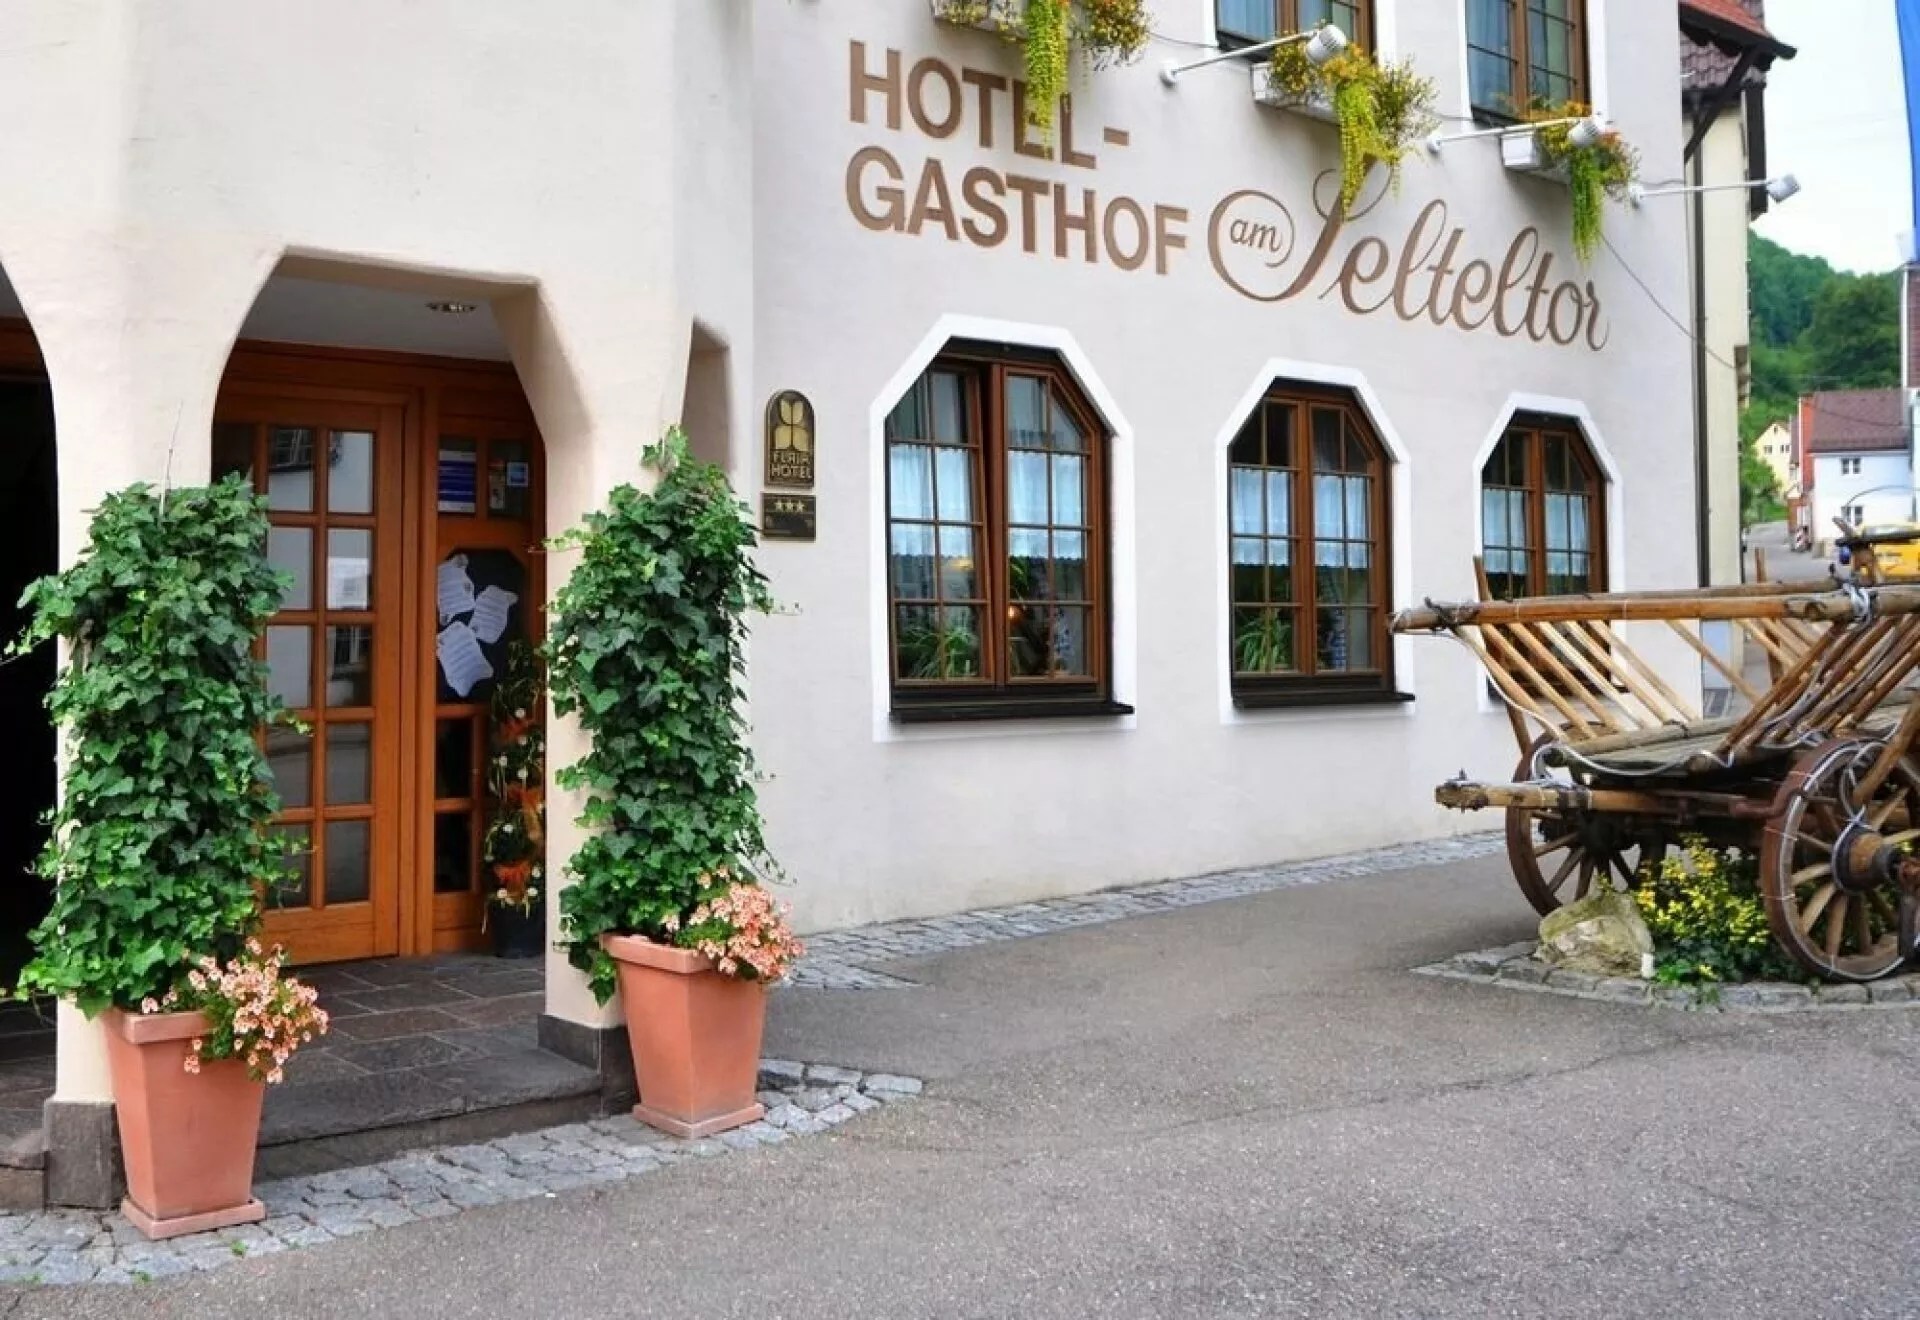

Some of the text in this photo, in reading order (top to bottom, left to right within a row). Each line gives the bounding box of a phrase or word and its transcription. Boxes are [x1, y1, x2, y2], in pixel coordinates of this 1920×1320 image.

[846, 145, 1610, 351] GASTHOF am Selteltor
[771, 463, 813, 479] HOTEL
